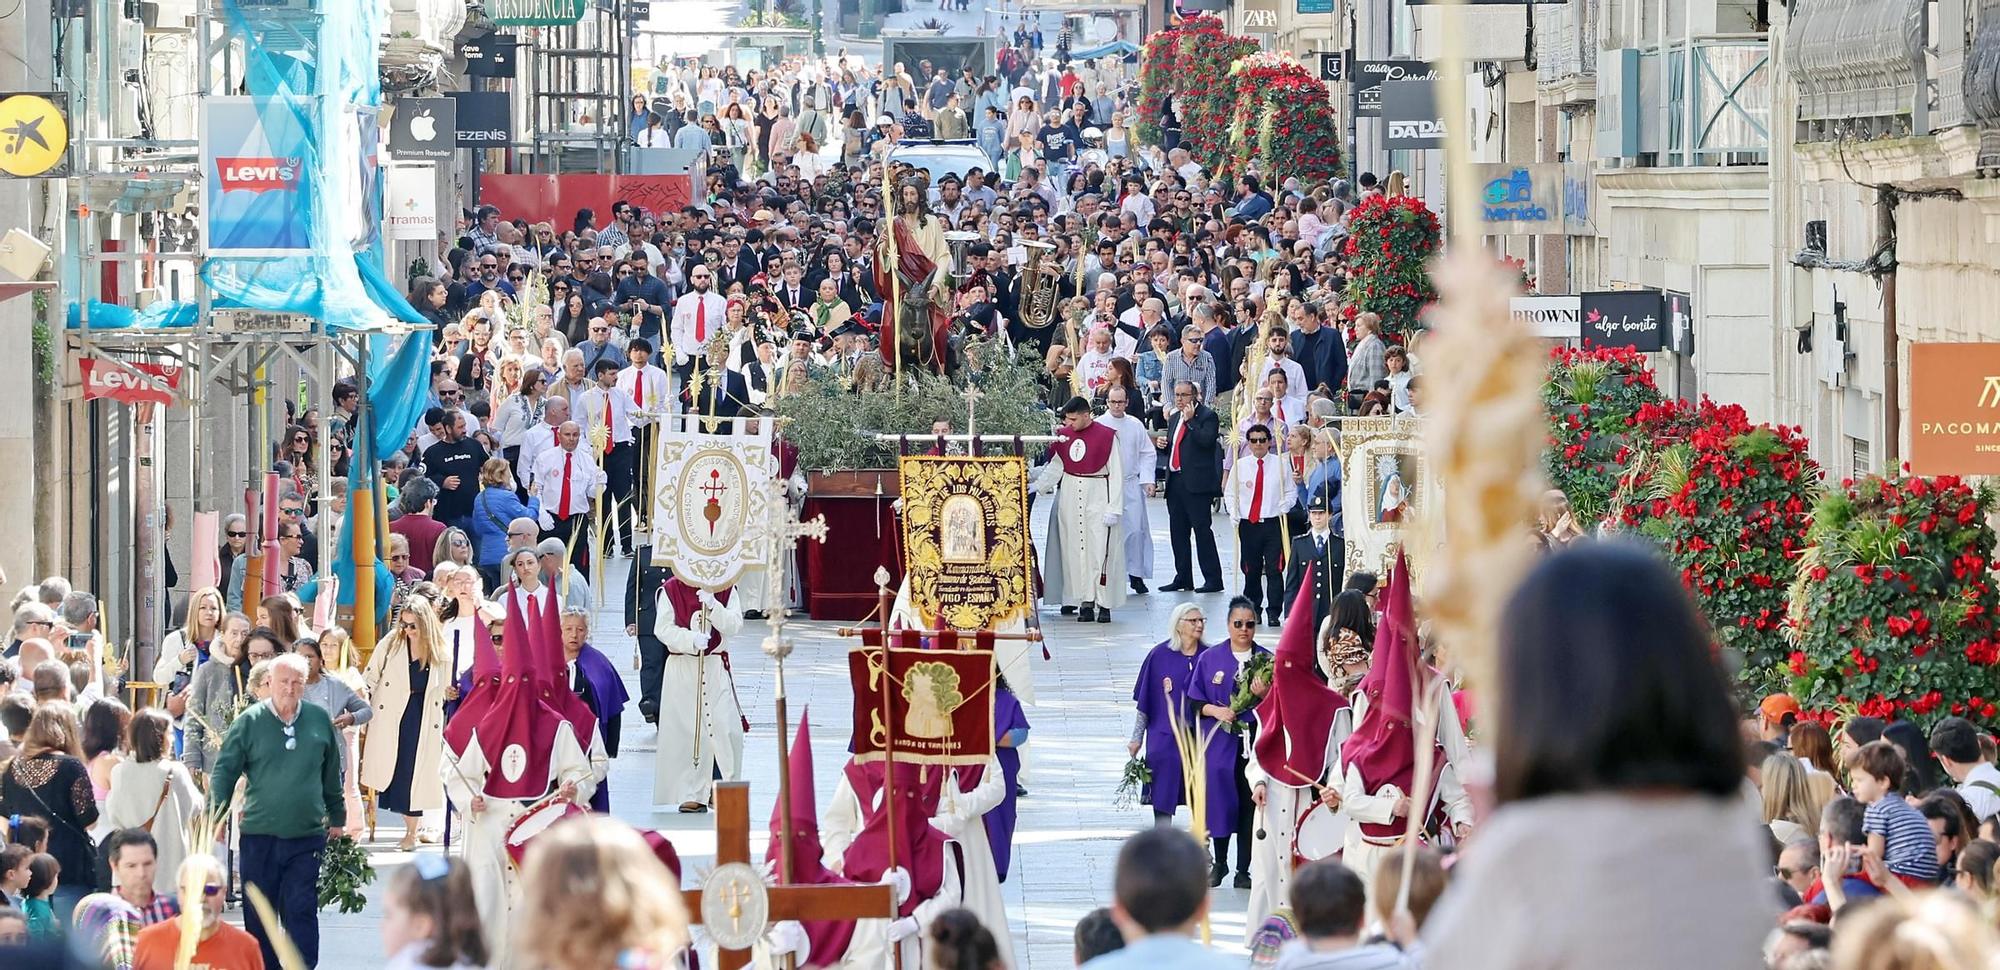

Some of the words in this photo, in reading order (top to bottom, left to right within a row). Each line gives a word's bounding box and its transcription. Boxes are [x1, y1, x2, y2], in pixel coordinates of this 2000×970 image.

[495, 0, 577, 19] RESIDENCIA
[1244, 10, 1277, 26] ZARA
[1364, 63, 1391, 73] casa
[396, 149, 424, 157] Premium
[425, 149, 451, 157] Reseller
[1484, 203, 1547, 221] venida
[1594, 315, 1619, 338] algo
[1622, 315, 1658, 332] bonito
[952, 484, 968, 494] LOS
[939, 593, 961, 603] VIGO
[917, 741, 926, 749] DE
